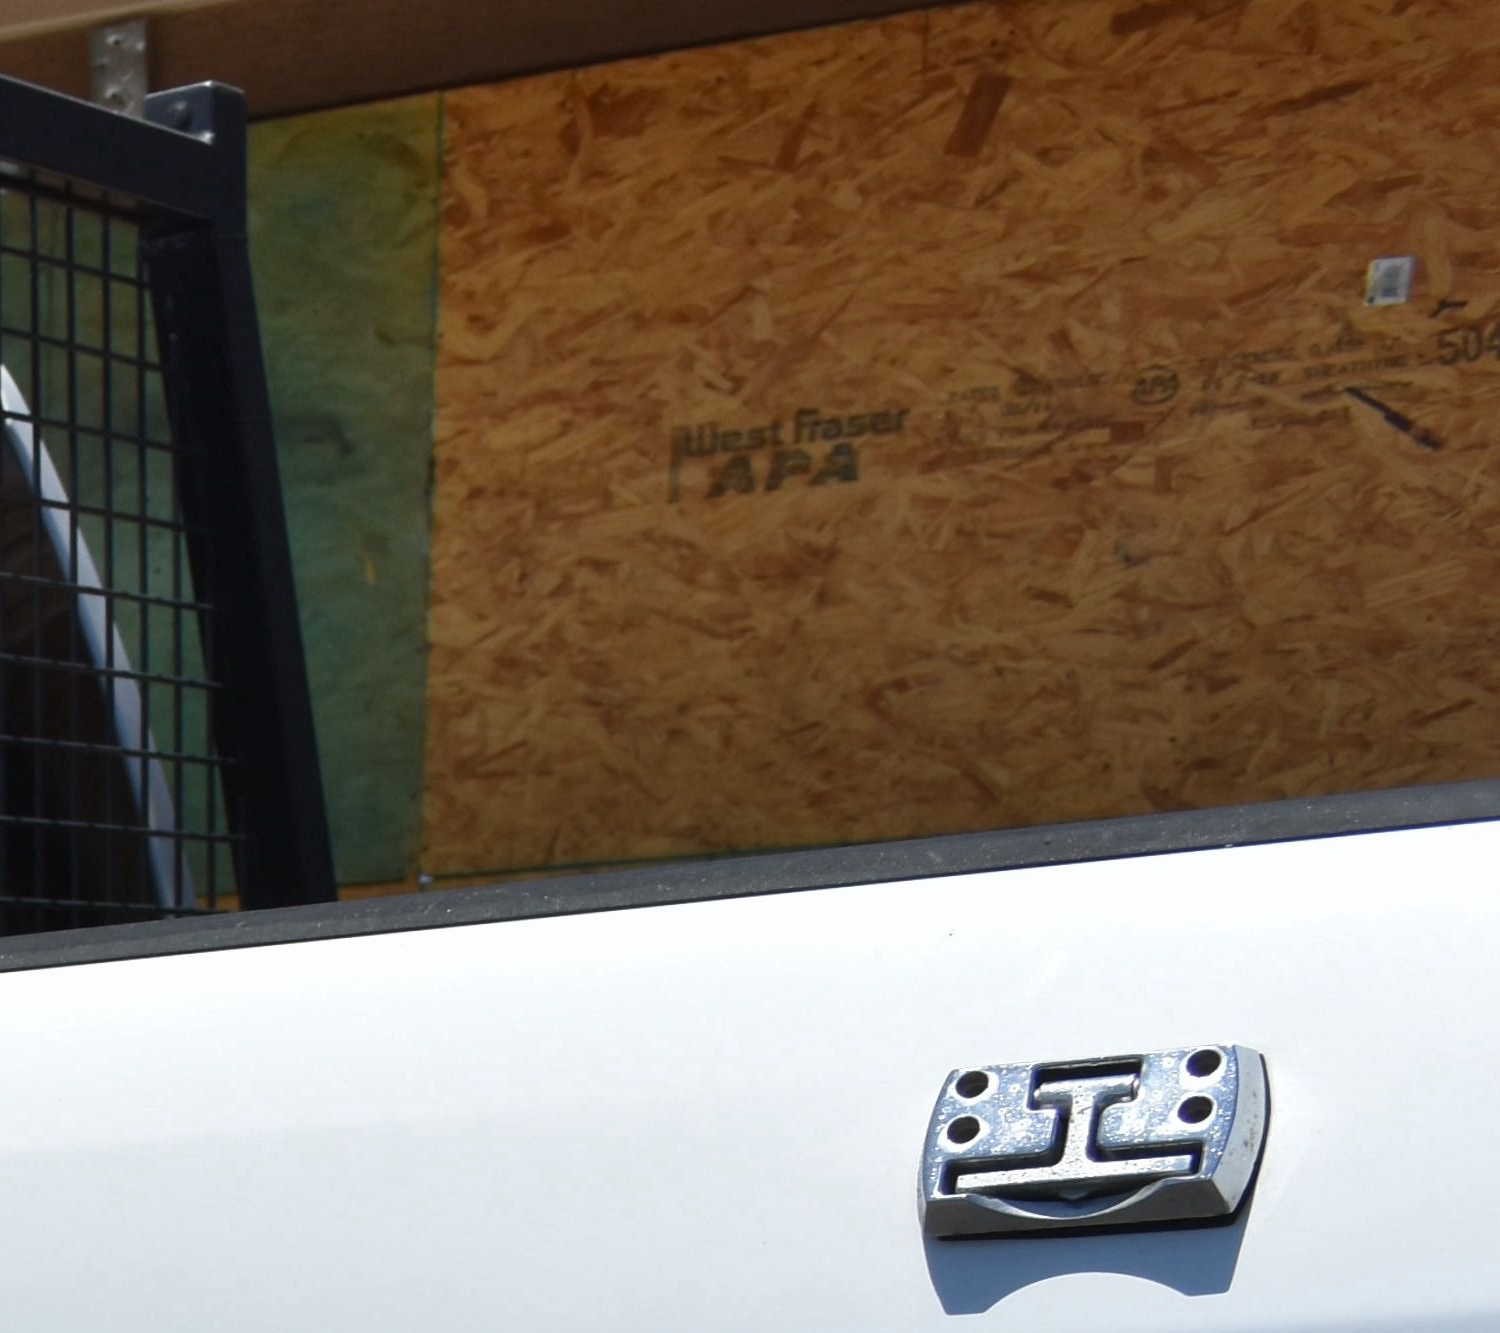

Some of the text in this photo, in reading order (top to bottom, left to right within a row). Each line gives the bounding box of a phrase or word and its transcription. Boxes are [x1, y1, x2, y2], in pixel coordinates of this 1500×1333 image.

[683, 407, 911, 457] West Fraser
[707, 442, 859, 499] APA
